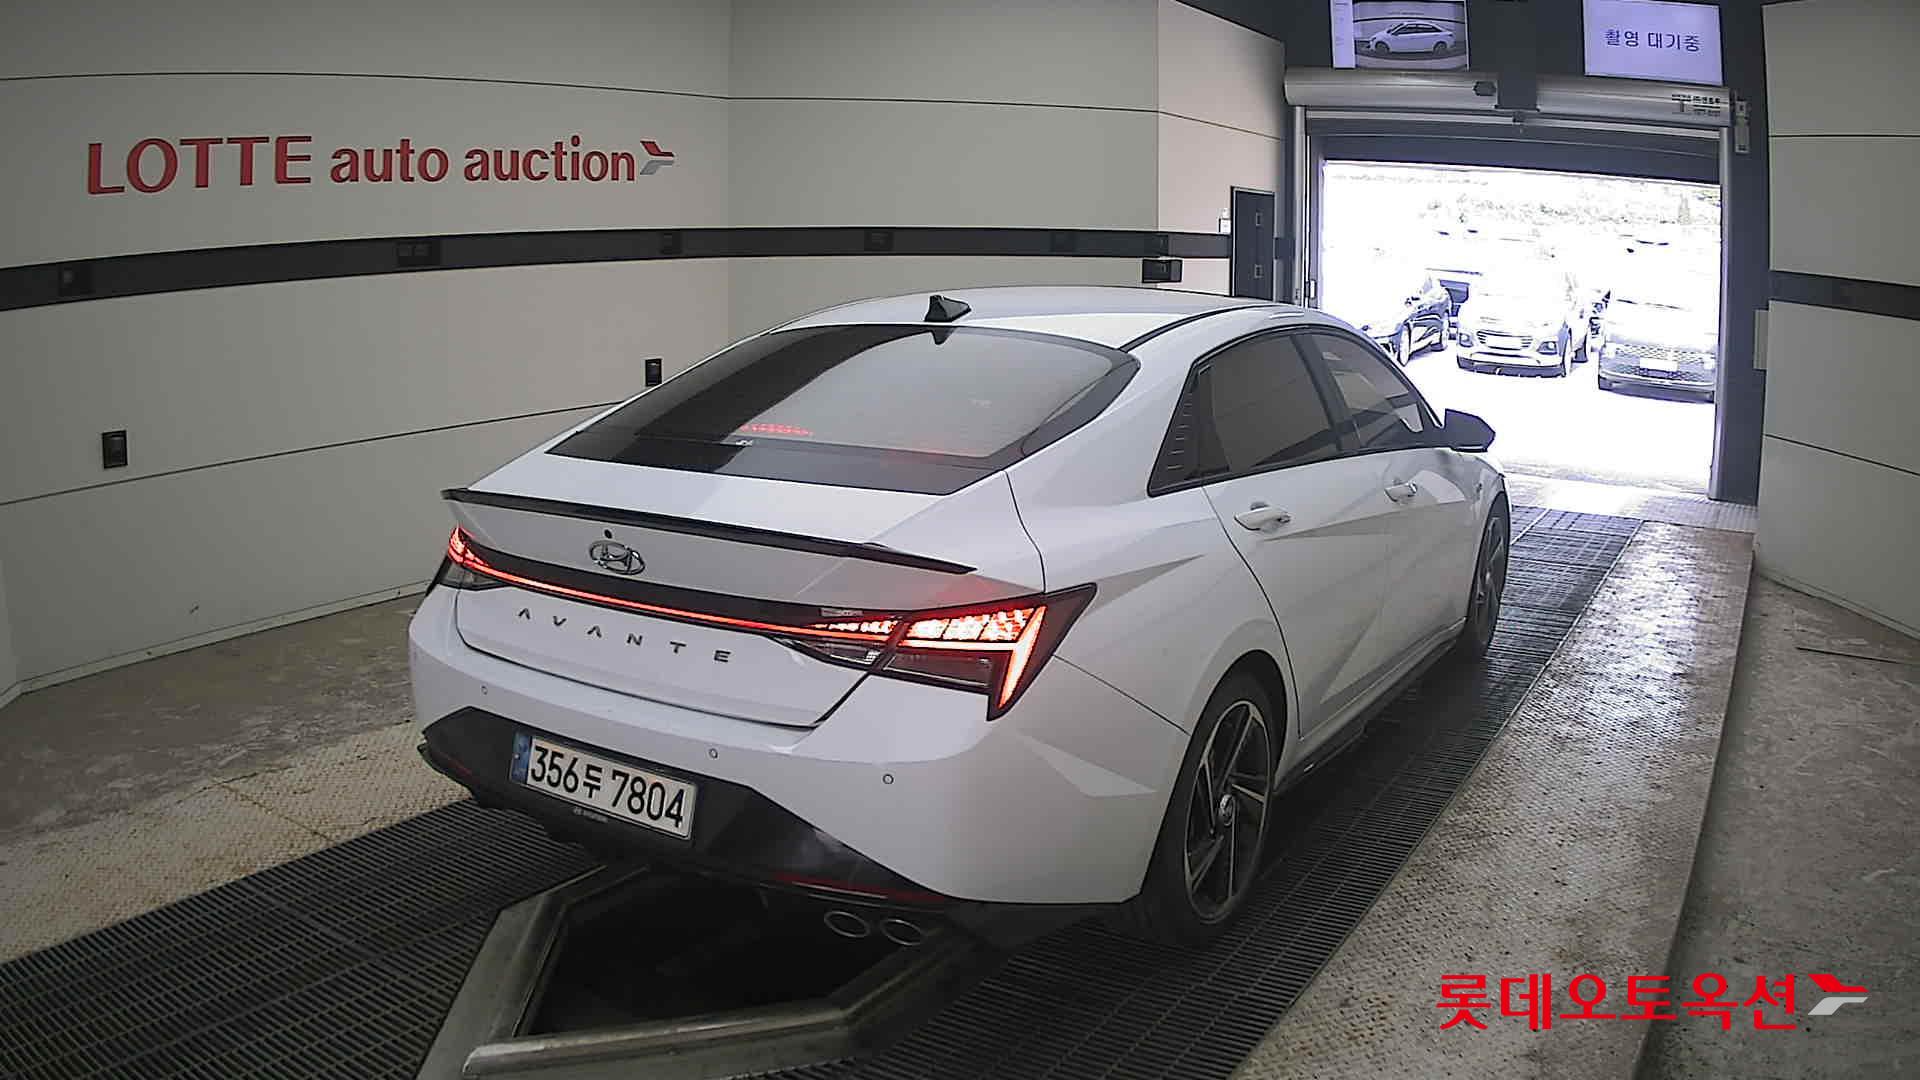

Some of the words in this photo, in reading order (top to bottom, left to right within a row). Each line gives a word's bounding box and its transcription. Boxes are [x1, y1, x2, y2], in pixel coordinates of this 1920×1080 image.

[1647, 31, 1700, 52] 대기중
[87, 136, 312, 195] LOTTE
[329, 138, 449, 183] auto
[463, 134, 636, 183] auction
[518, 607, 731, 663] AVANTE
[611, 769, 686, 828] 7804
